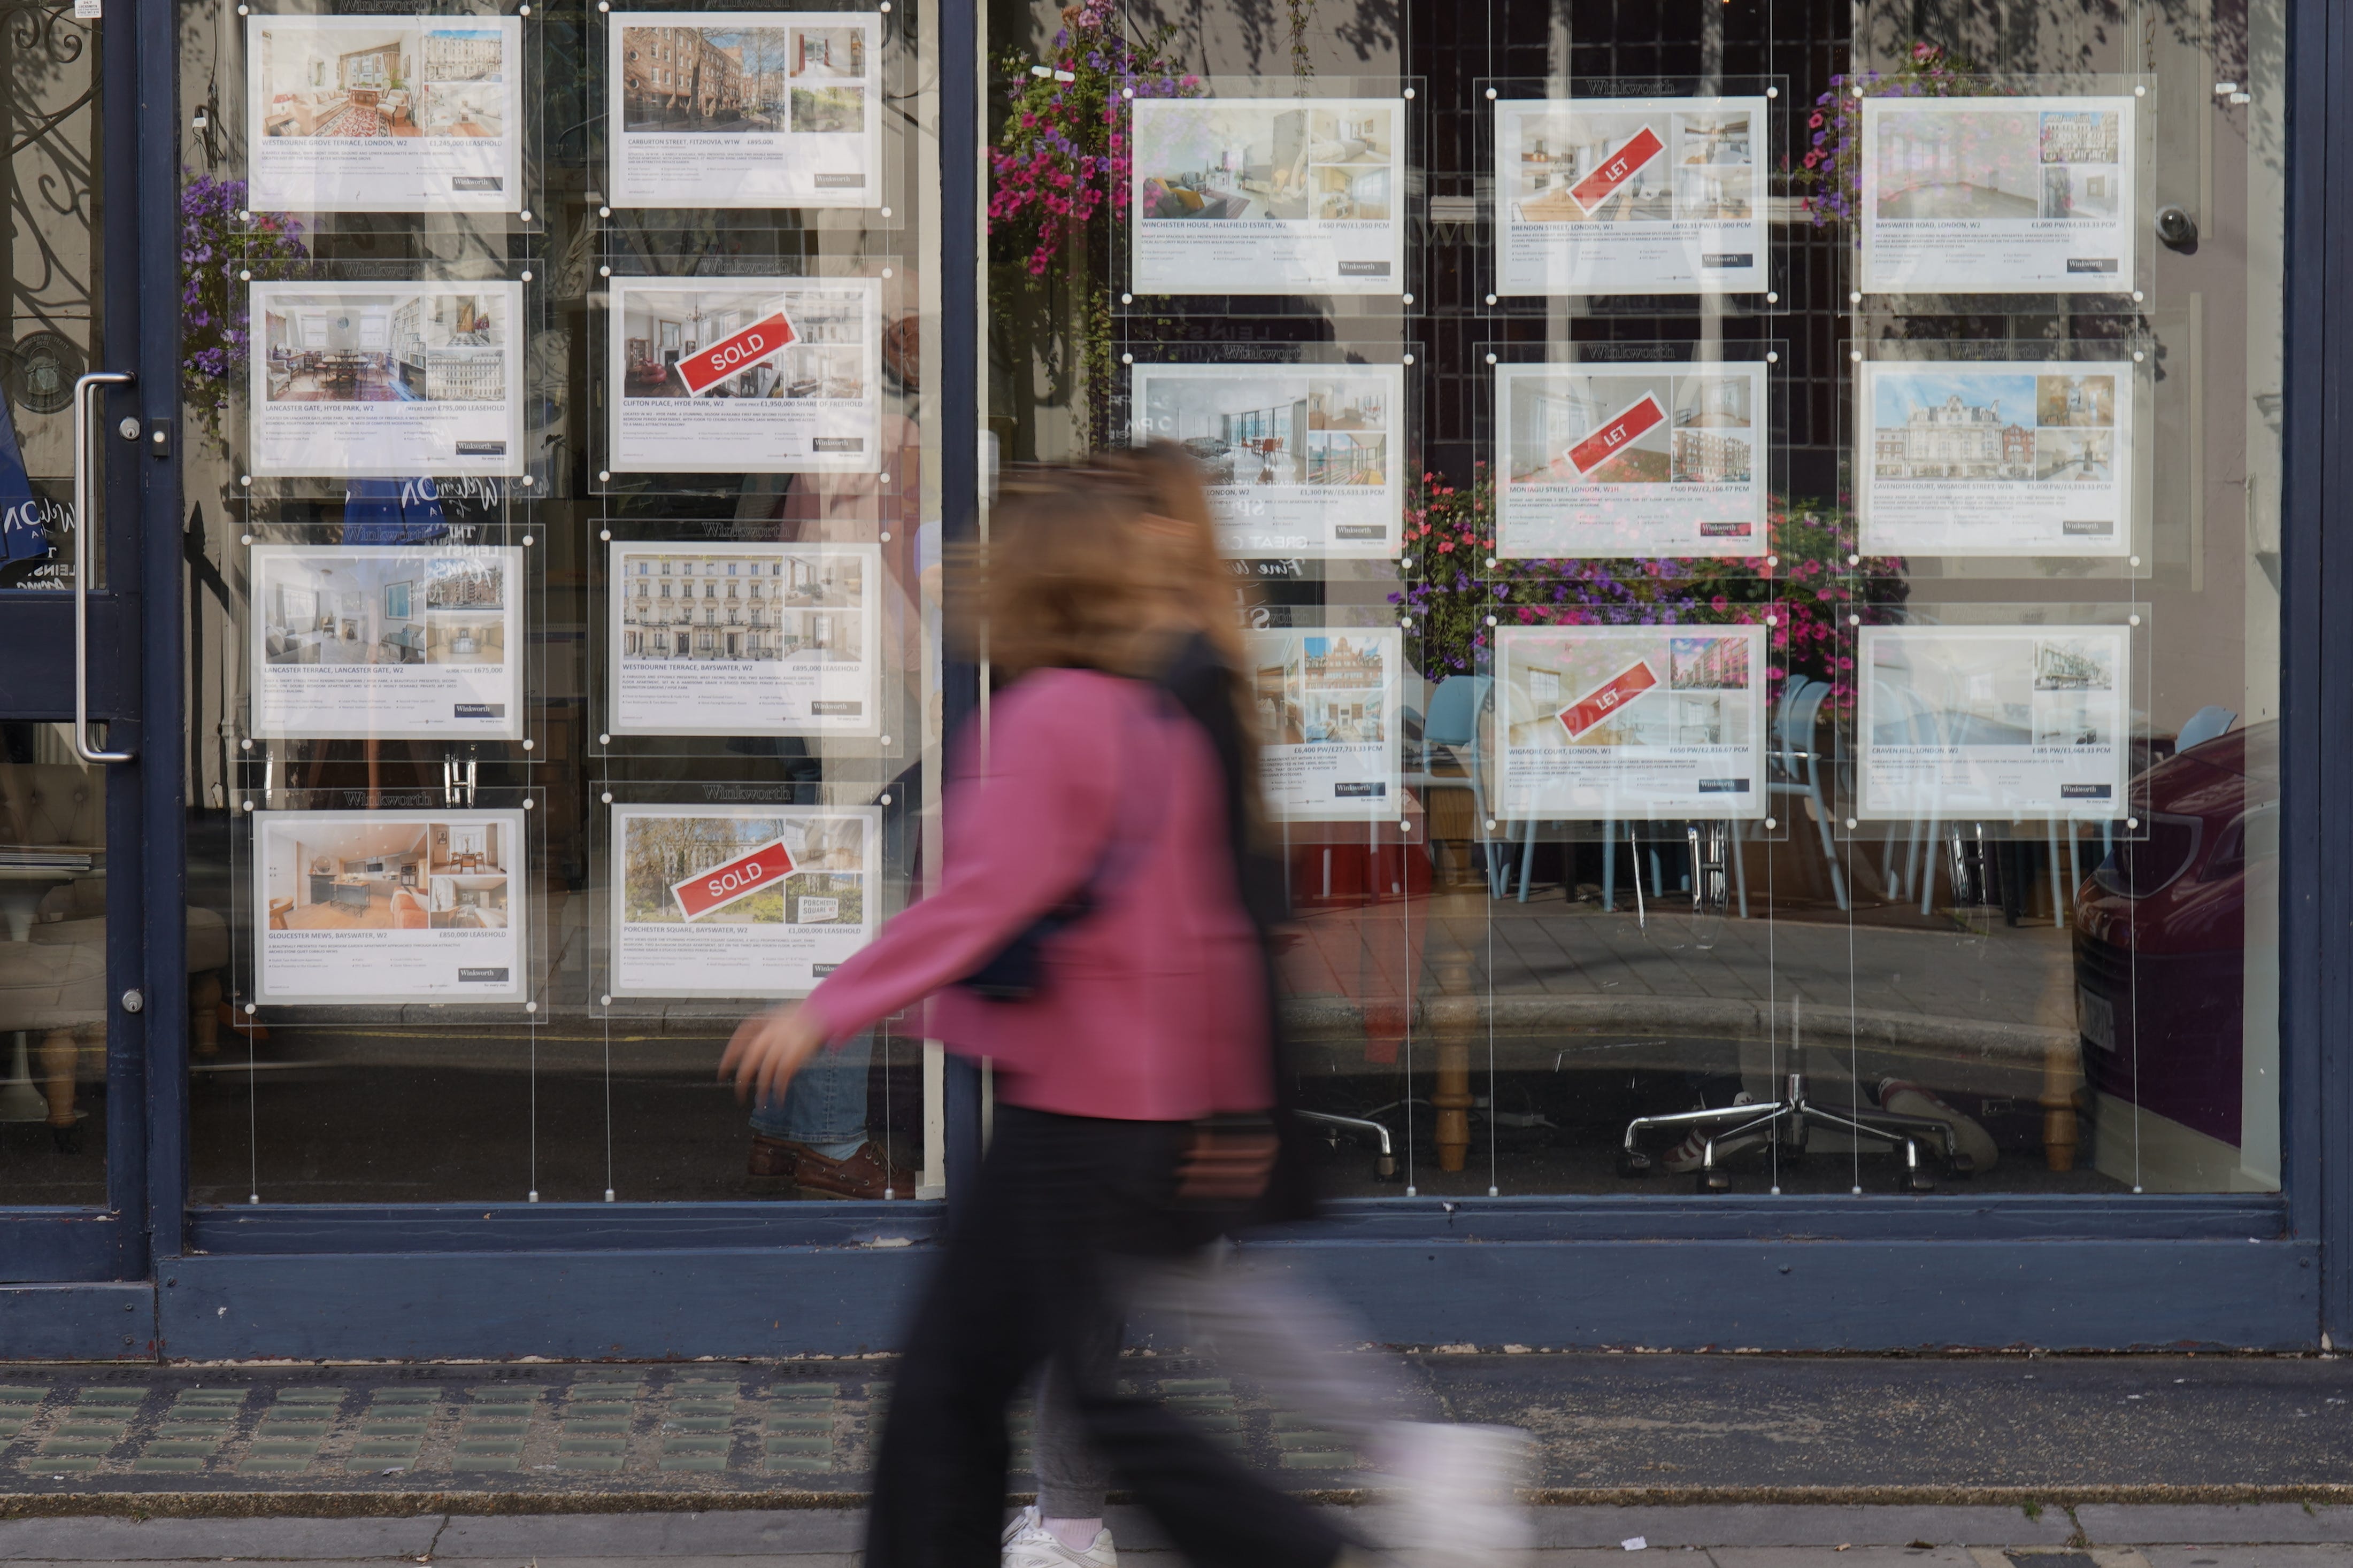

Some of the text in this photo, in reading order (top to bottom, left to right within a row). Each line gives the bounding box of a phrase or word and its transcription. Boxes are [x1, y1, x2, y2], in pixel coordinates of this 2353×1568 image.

[1587, 80, 1675, 95] Winkworth
[1605, 157, 1629, 182] LET
[701, 258, 789, 273] Winkworth
[711, 334, 764, 371] SOLD
[1587, 344, 1675, 359] Winkworth
[1604, 423, 1627, 447] LET
[702, 522, 790, 538] Winkworth
[1596, 688, 1620, 712] LET
[344, 791, 432, 807] Winkworth
[703, 785, 791, 800] Winkworth
[708, 862, 762, 897] SOLD
